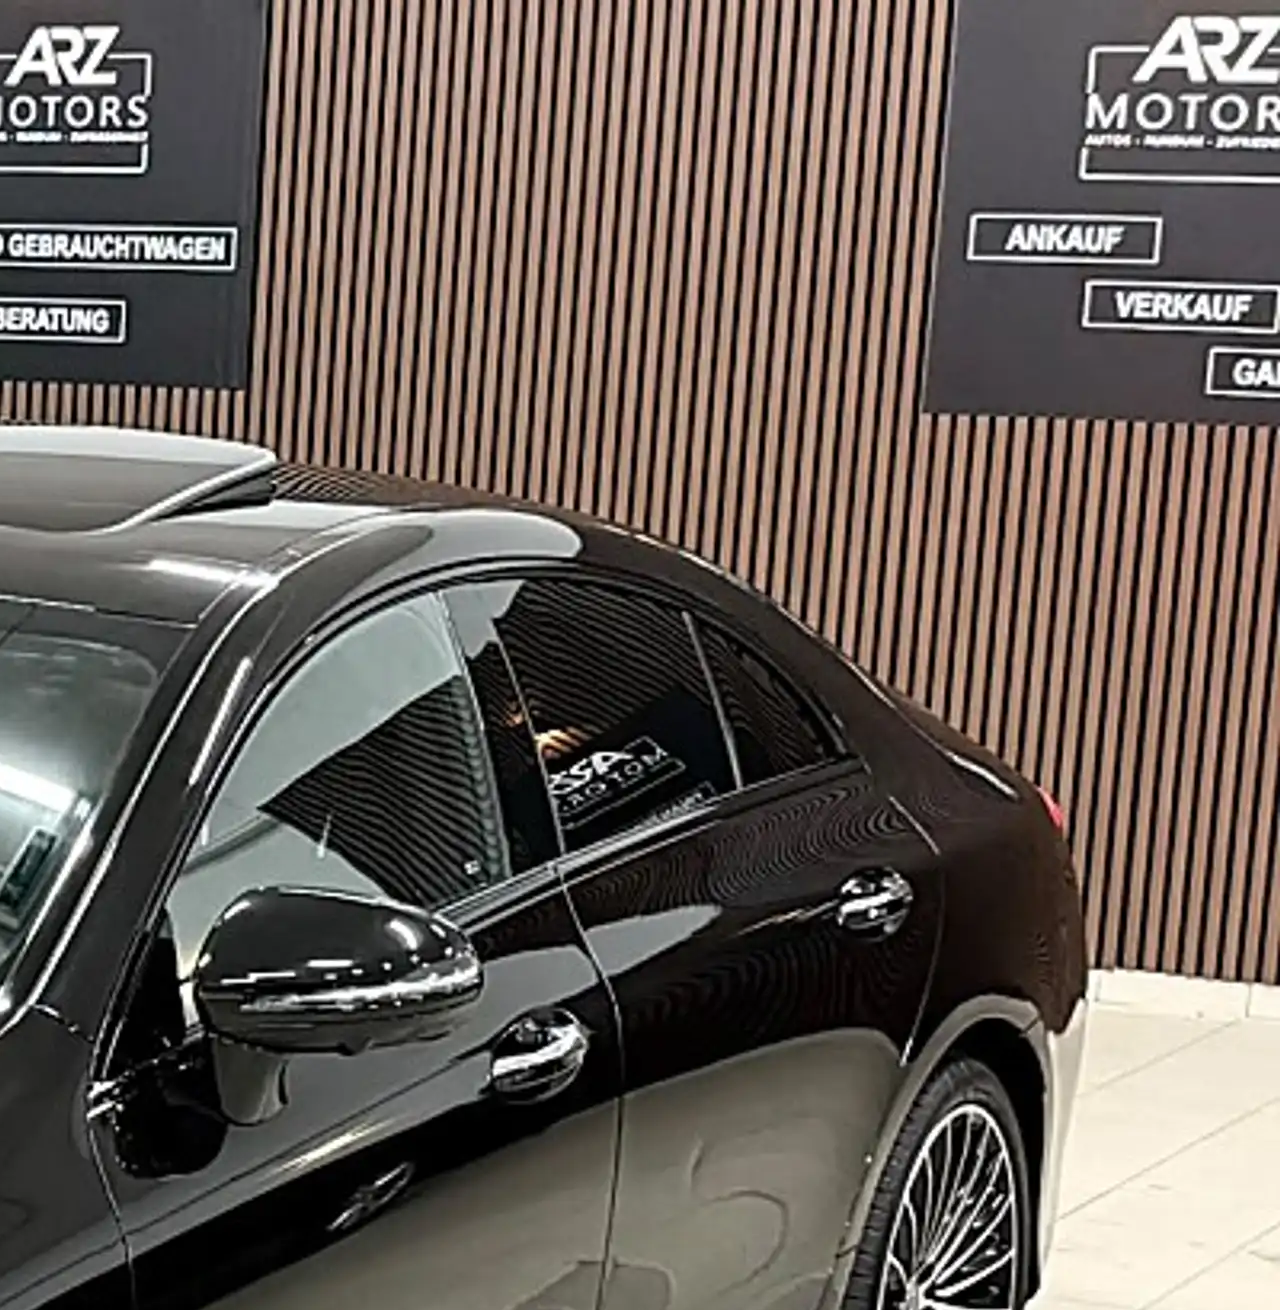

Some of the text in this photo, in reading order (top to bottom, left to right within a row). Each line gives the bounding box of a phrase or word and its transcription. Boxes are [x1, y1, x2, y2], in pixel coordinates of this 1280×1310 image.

[3, 24, 121, 87] ARZ
[1132, 15, 1280, 85] ARZ
[9, 233, 226, 262] GEBRAUCHTWAGEN
[1004, 224, 1125, 254] ANKAUF
[1114, 290, 1253, 322] VERKAUF
